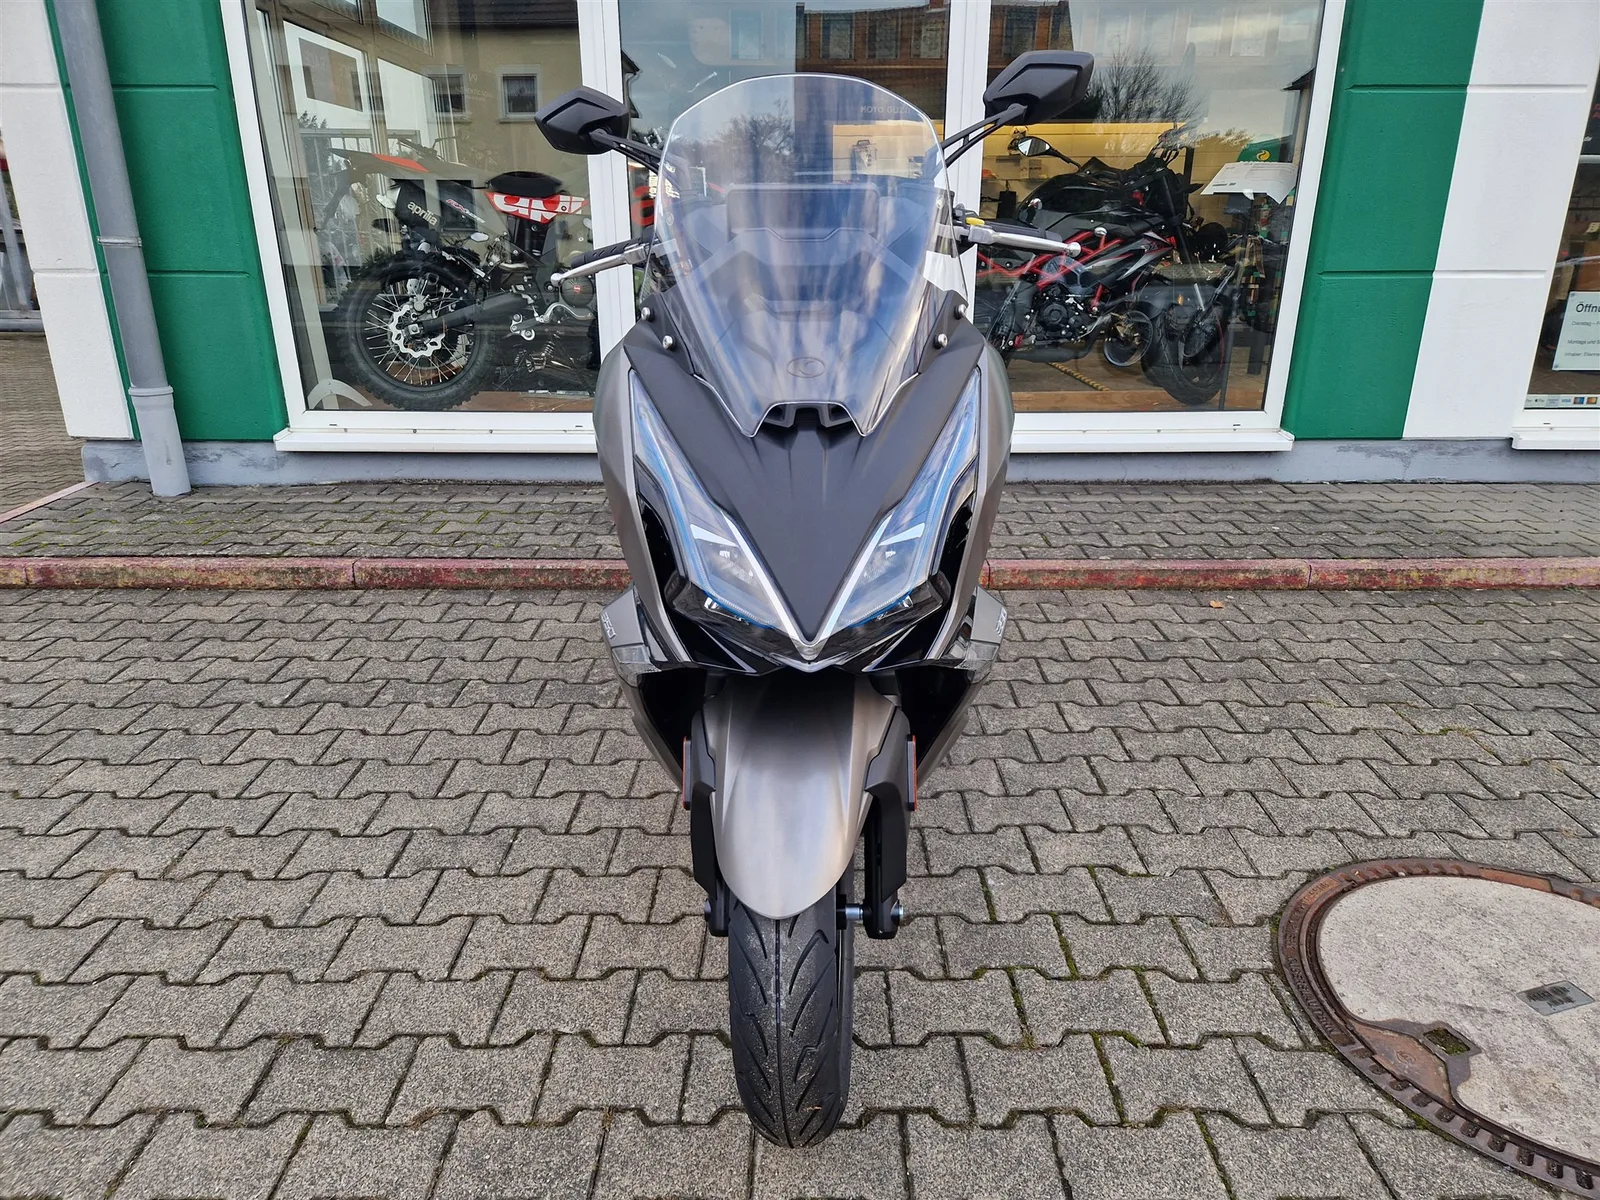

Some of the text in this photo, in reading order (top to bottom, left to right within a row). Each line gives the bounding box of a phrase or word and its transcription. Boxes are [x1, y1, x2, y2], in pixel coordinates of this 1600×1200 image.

[860, 105, 884, 114] MOTO
[407, 201, 438, 226] aprilia
[601, 611, 617, 640] 350
